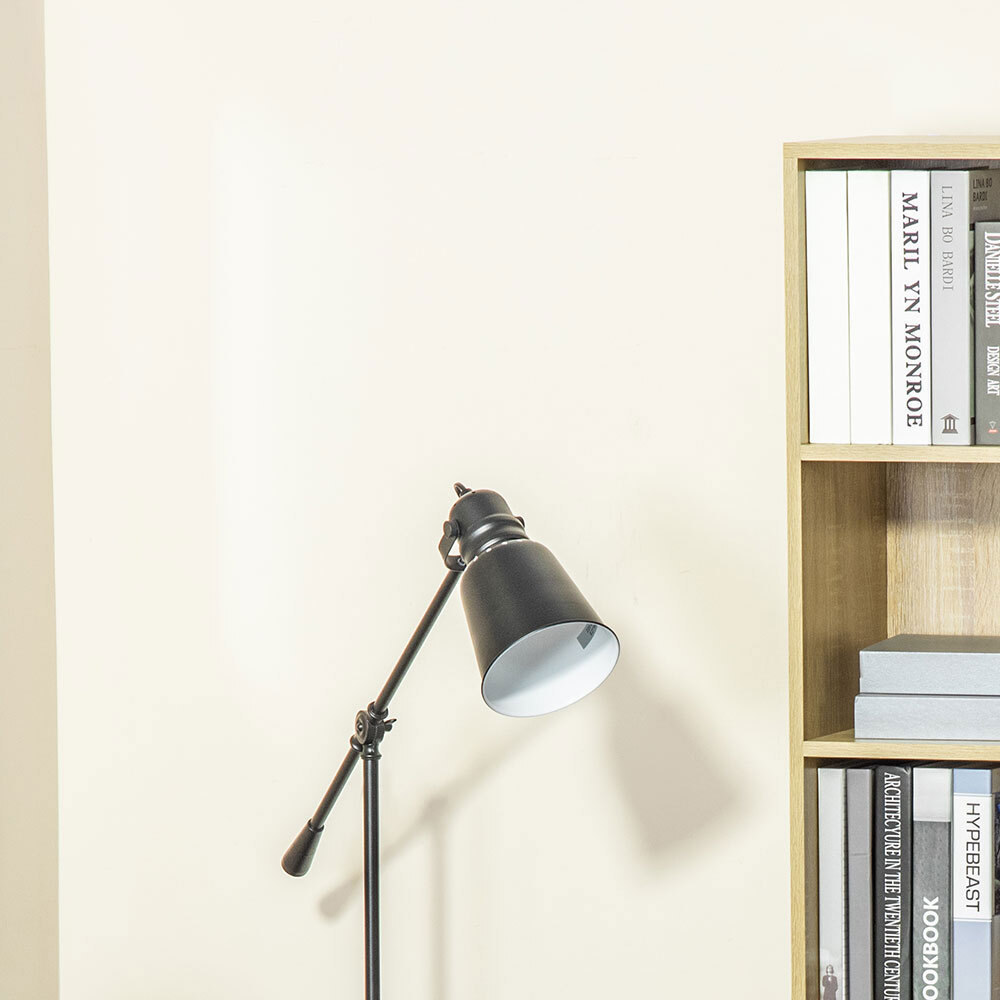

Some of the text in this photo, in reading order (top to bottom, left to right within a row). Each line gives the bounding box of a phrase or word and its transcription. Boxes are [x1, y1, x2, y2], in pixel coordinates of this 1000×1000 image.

[901, 192, 920, 271] MARIL
[941, 185, 954, 291] LINA BO BARDI
[905, 323, 923, 428] MONROE
[986, 344, 1000, 397] DESIGN ART
[884, 855, 902, 870] IN
[884, 872, 902, 896] THE
[965, 802, 981, 913] HYPEBEAST
[884, 896, 902, 958] TWENTIETH
